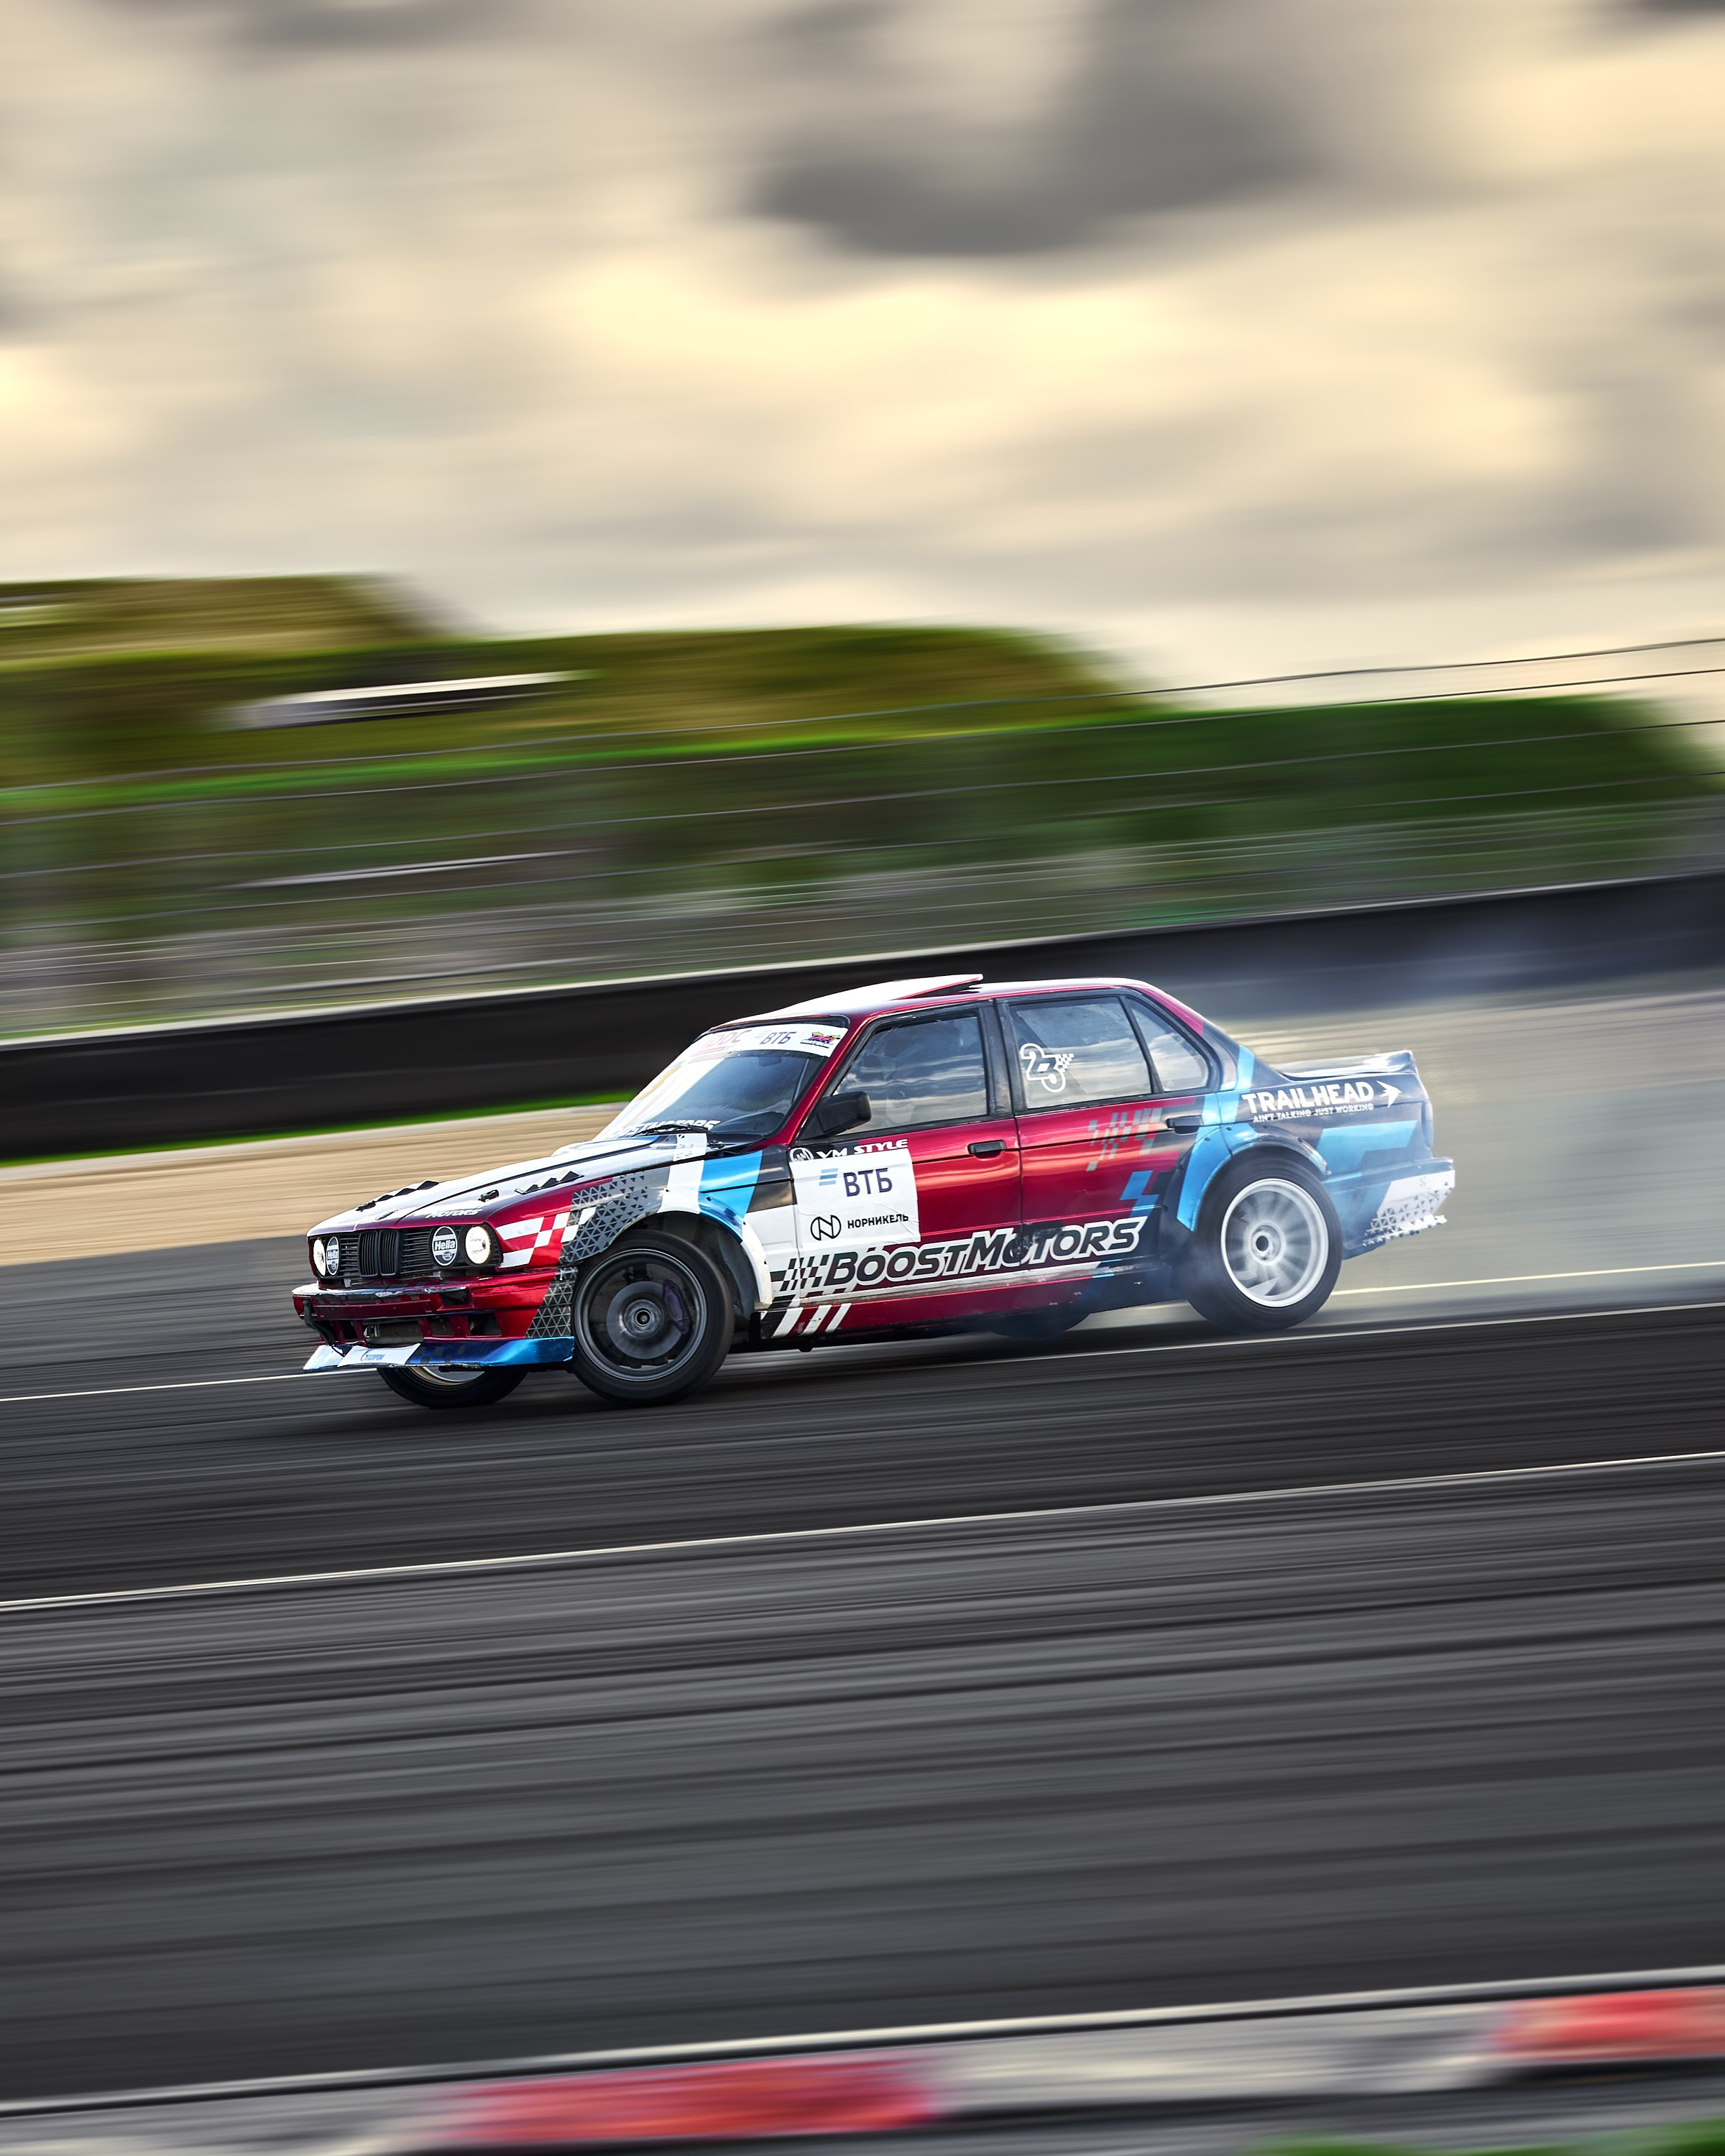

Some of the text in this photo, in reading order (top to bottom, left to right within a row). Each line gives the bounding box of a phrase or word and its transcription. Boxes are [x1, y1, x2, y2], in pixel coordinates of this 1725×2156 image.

[759, 1031, 797, 1045] ВТБ
[1020, 1043, 1066, 1092] 23
[1241, 1082, 1374, 1114] TRAILHEAD
[1253, 1102, 1374, 1123] AIN'T TALKING JUST WORKING
[816, 1139, 908, 1158] VM STYLE
[843, 1168, 893, 1197] ВТБ
[847, 1214, 909, 1229] НОРНИКЕЛЬ
[434, 1240, 456, 1250] Hella
[824, 1216, 1149, 1286] BOOSTMOTORS
